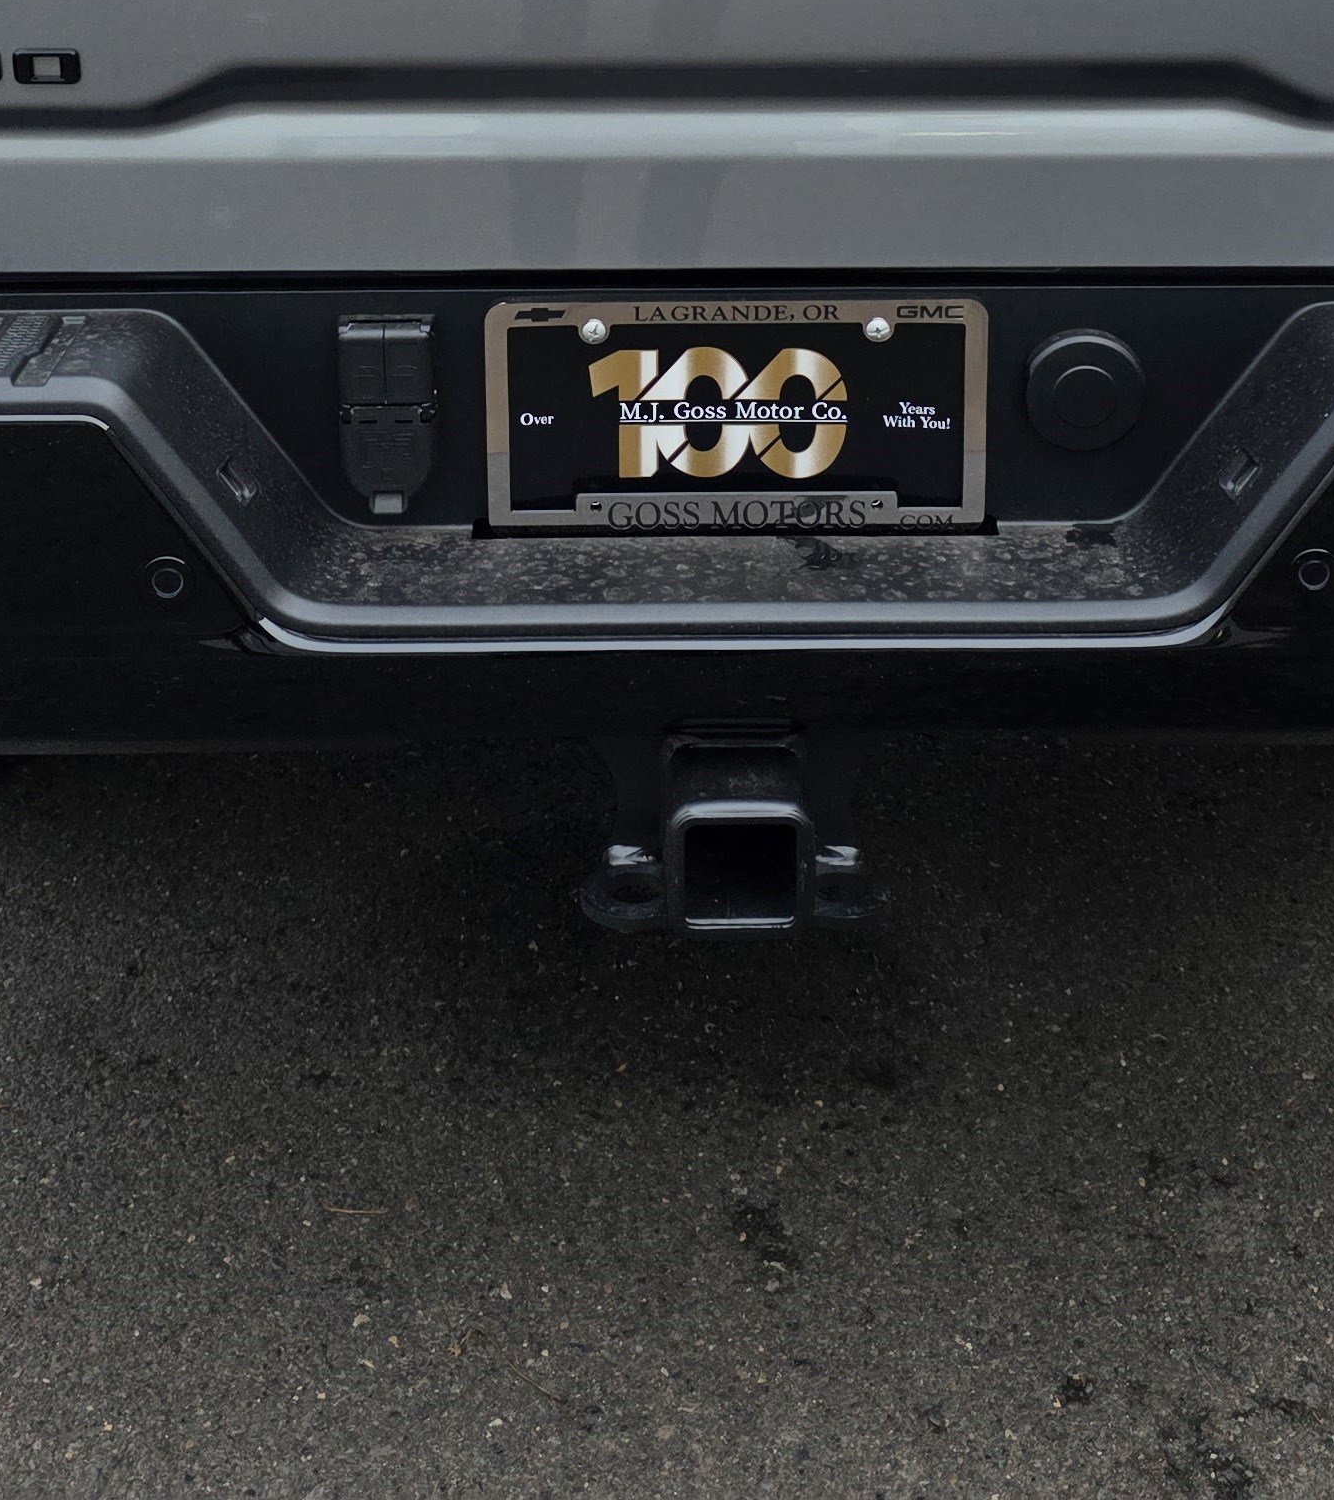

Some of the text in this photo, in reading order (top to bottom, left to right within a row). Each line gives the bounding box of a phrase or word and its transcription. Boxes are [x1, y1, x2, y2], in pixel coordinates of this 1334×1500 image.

[803, 304, 840, 320] OR
[896, 305, 964, 318] GMC
[588, 347, 848, 479] 100
[619, 402, 847, 423] M.J. Goss Motor Co.
[899, 401, 936, 415] Years
[520, 412, 554, 426] Over
[882, 414, 951, 430] With You!
[607, 499, 866, 530] GOSS MOTORS
